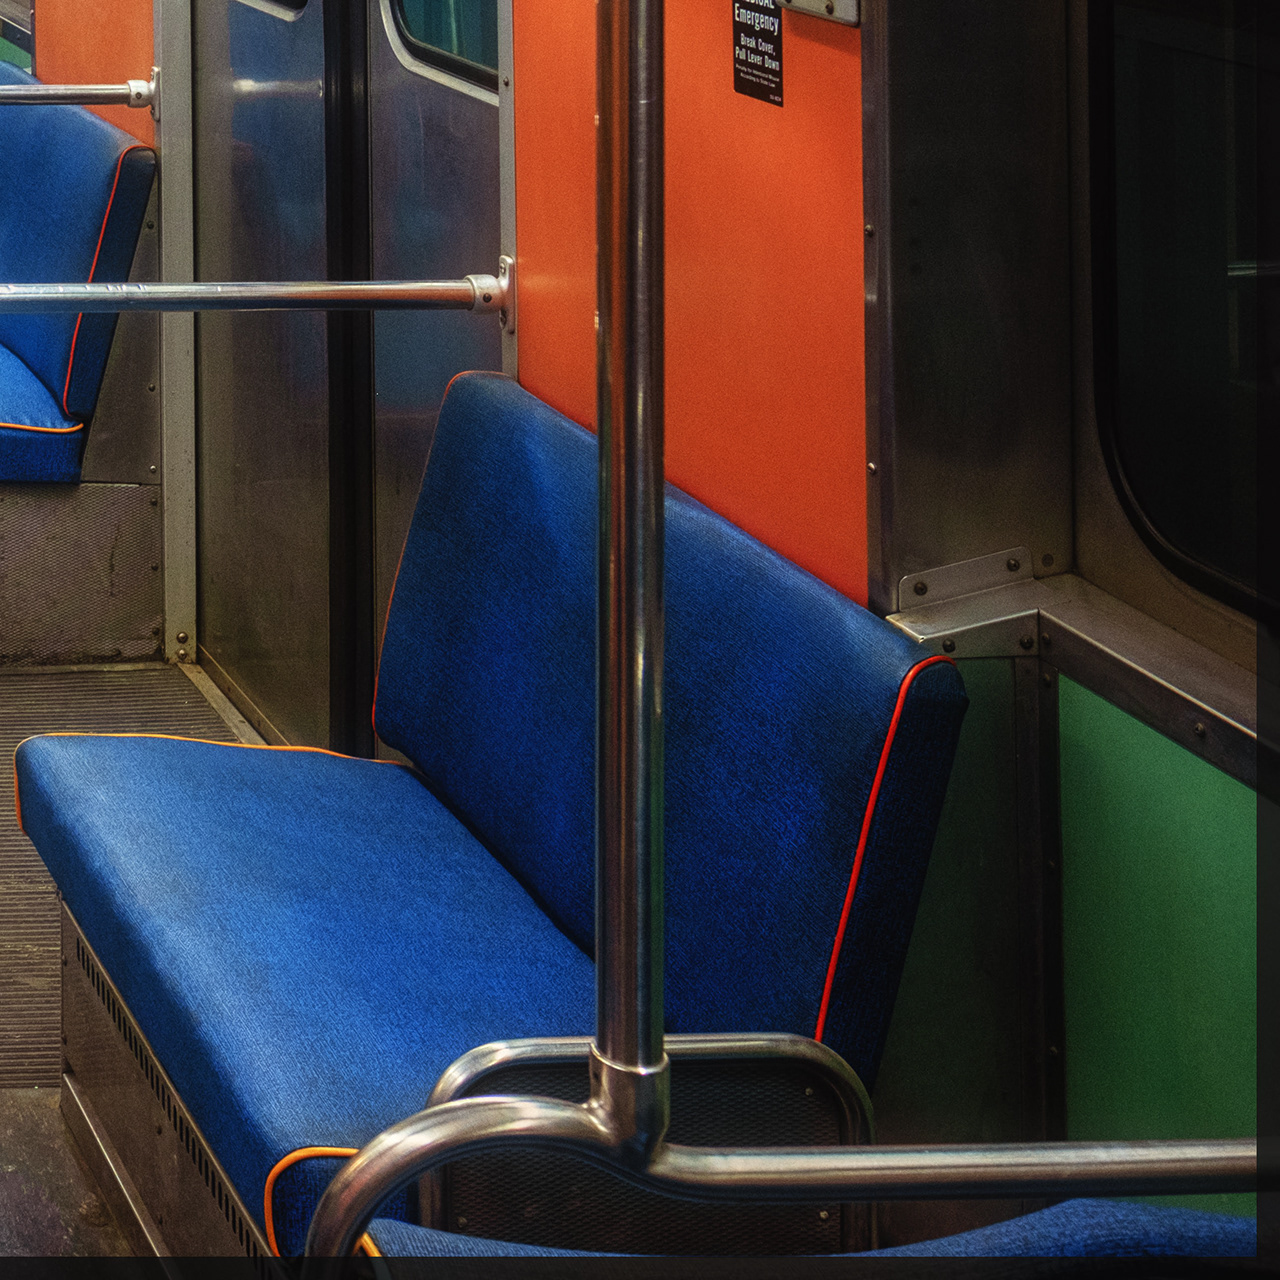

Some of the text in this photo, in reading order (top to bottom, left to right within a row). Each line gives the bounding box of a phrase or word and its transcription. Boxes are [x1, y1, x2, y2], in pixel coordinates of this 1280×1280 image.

[734, 2, 780, 37] Emergency
[740, 32, 777, 56] Break Cover,
[735, 45, 781, 72] Pull Lever Down
